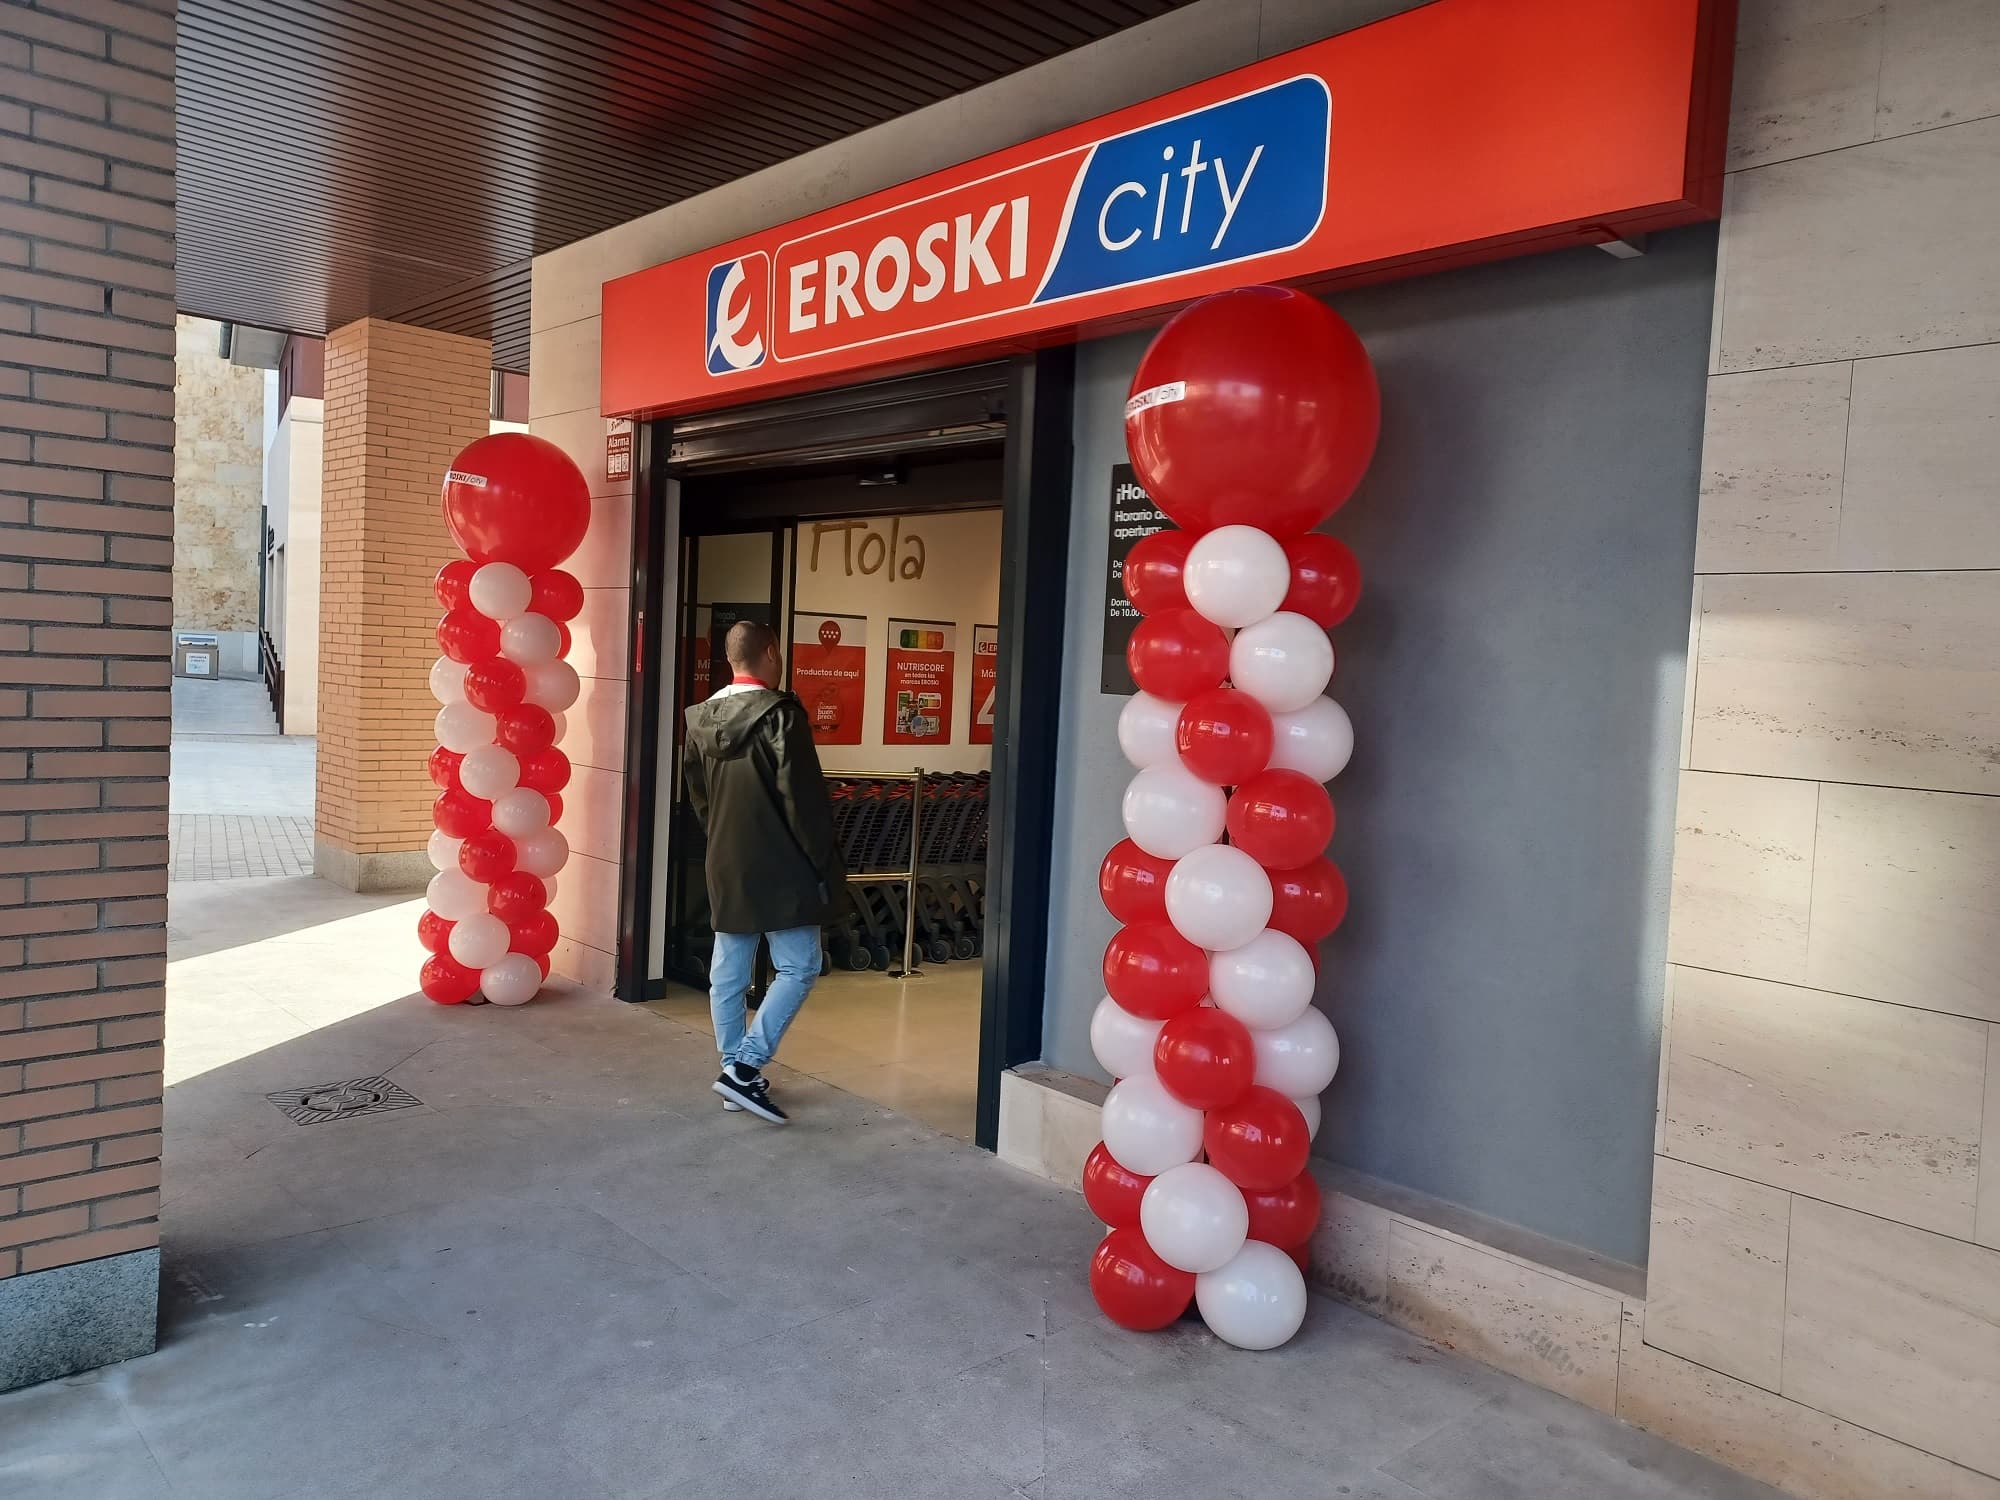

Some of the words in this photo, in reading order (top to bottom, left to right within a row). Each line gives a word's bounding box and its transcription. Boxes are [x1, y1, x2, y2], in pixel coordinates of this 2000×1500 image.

[788, 195, 1031, 334] EROSKI
[1098, 142, 1265, 250] city
[608, 436, 630, 449] Alarma
[1114, 509, 1153, 522] Horario
[810, 517, 926, 583] Hola
[1109, 608, 1120, 617] De
[796, 667, 832, 678] Productos
[833, 669, 843, 678] de
[896, 662, 945, 672] NUTRISCORE
